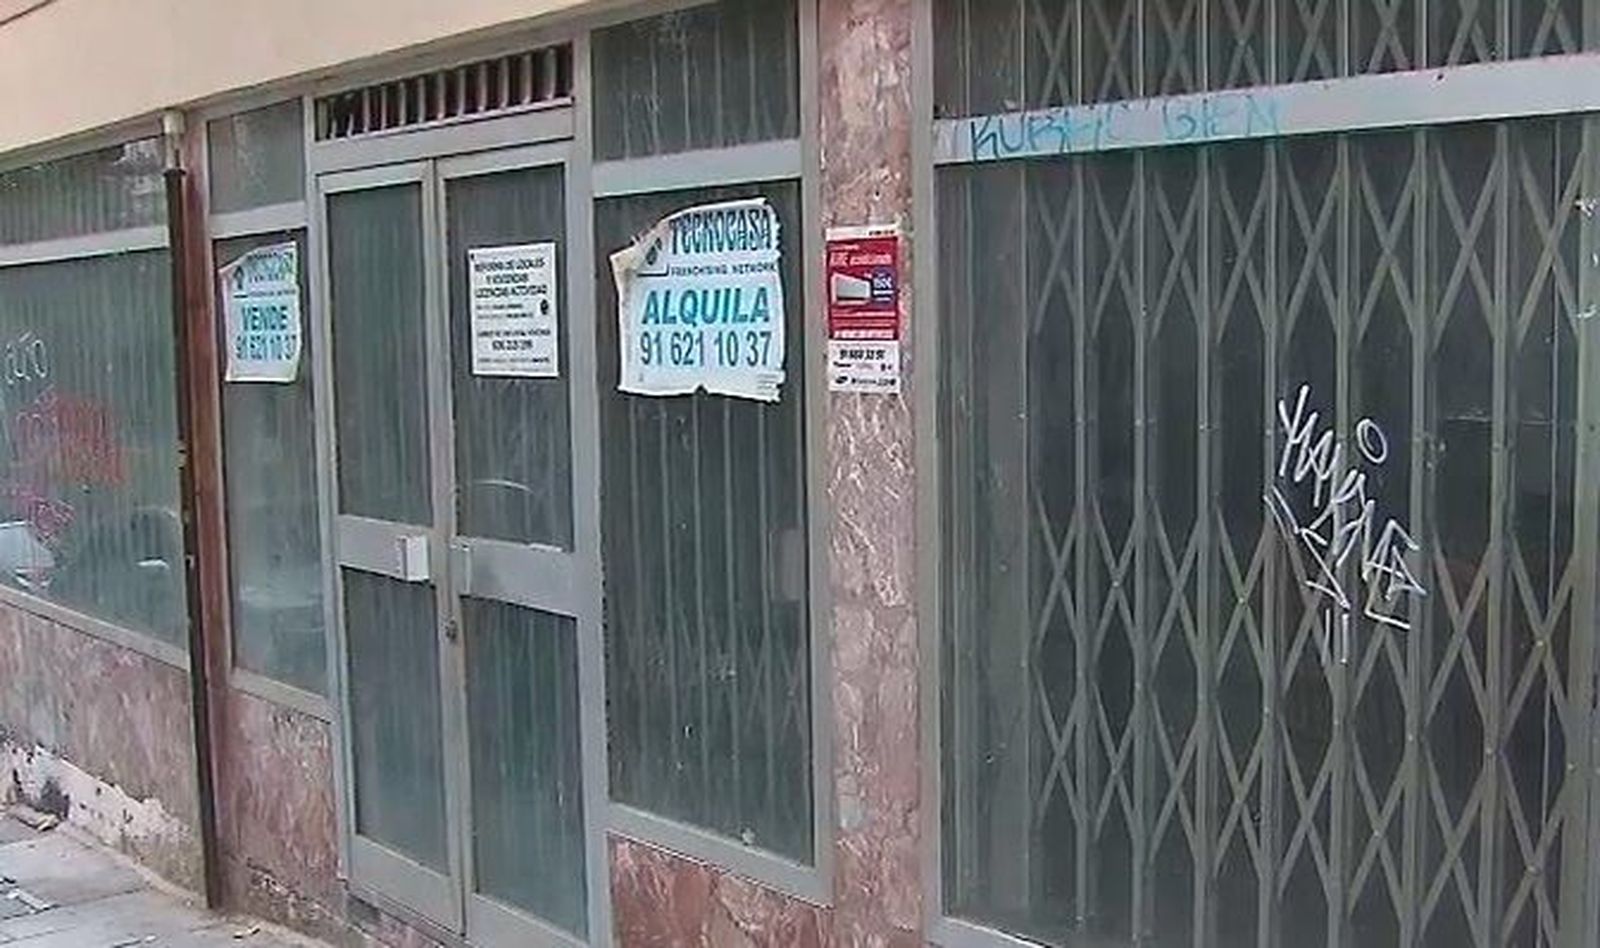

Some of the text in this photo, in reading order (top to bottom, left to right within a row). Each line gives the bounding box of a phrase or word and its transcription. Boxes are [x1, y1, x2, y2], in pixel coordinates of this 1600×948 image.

[669, 208, 772, 255] TECNOCASA
[242, 304, 288, 331] VENDE
[641, 287, 770, 327] ALQUILA
[640, 330, 773, 368] 91 621 10 37
